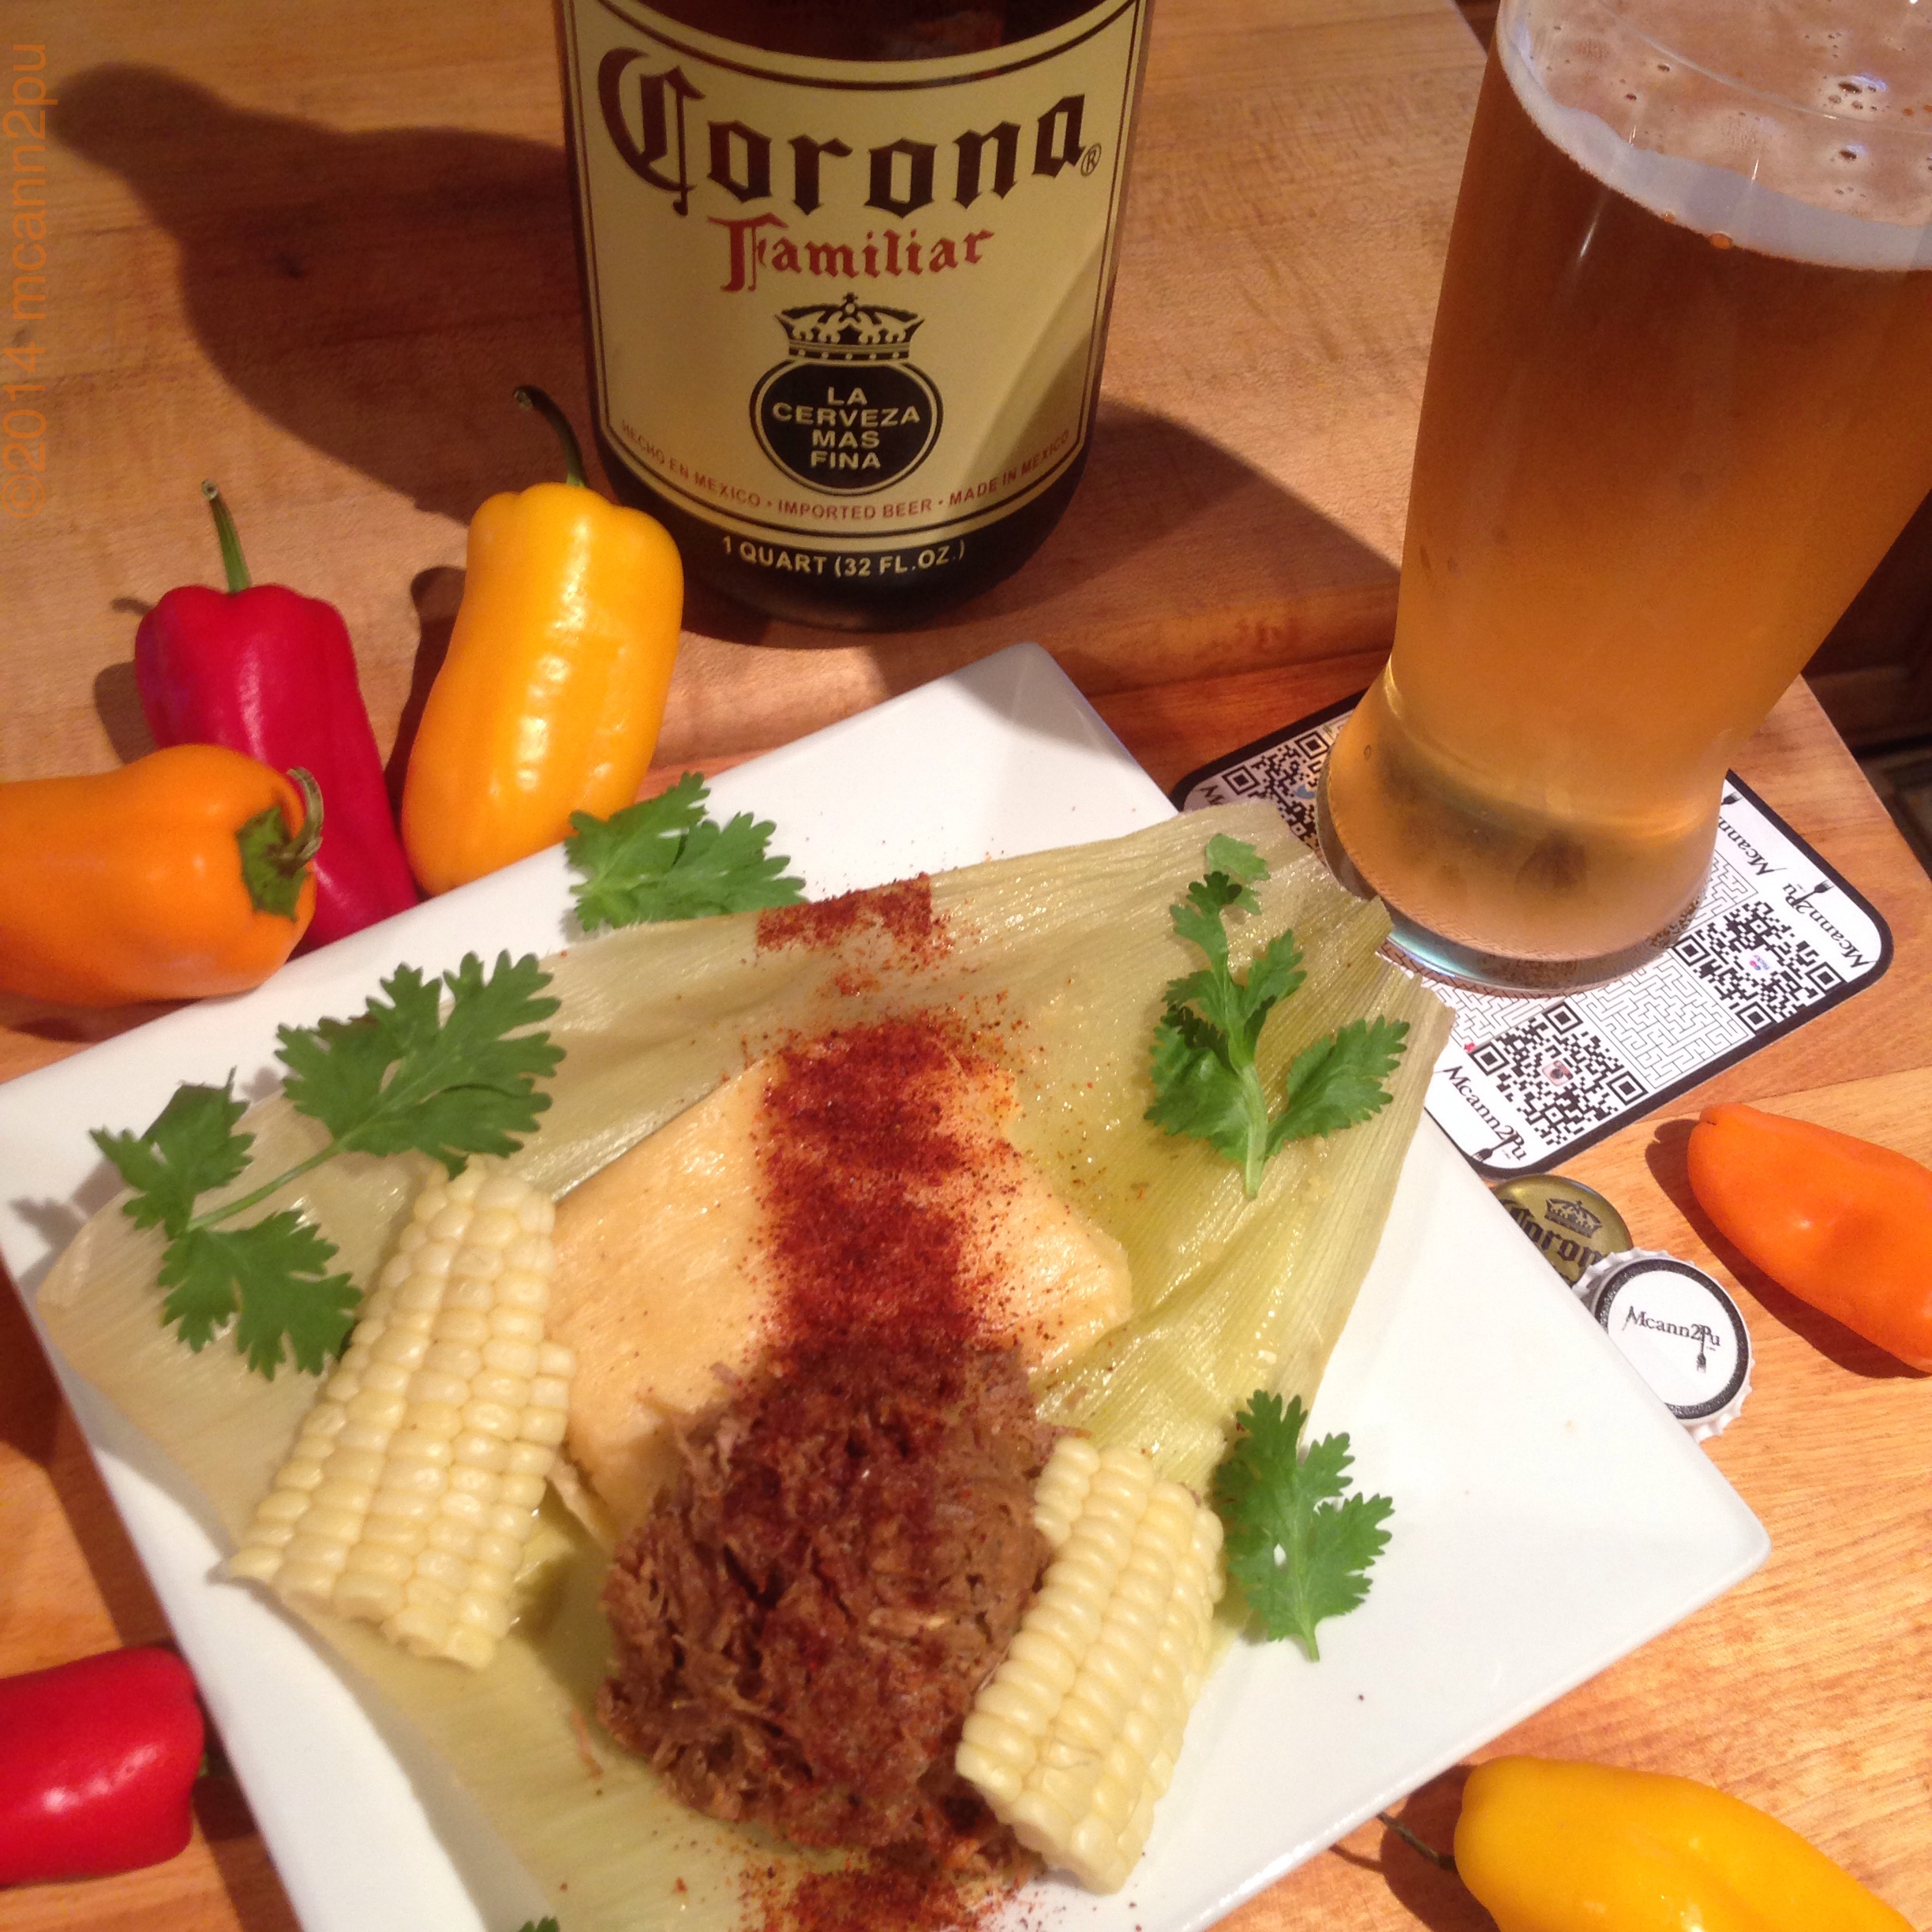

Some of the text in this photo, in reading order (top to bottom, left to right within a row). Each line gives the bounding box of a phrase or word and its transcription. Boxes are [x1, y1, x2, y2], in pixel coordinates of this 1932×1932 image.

[597, 47, 1088, 218] Corona
[708, 212, 995, 292] Familiar
[772, 402, 920, 428] CERVEZA
[827, 386, 867, 406] LA
[810, 450, 882, 470] FINA
[811, 429, 880, 449] MAS
[622, 419, 1069, 521] HECHO EN MEXICO IMPORTED BEER MADE IN MEXICO
[723, 535, 732, 554] 1
[739, 541, 827, 575] QUART
[834, 556, 871, 578] (32
[1719, 816, 1787, 876] Mcann
[1782, 880, 1878, 968] Mcann2Pu
[1435, 1065, 1527, 1162] Mcann2Pu
[1623, 1305, 1720, 1350] Mcann2Pu
